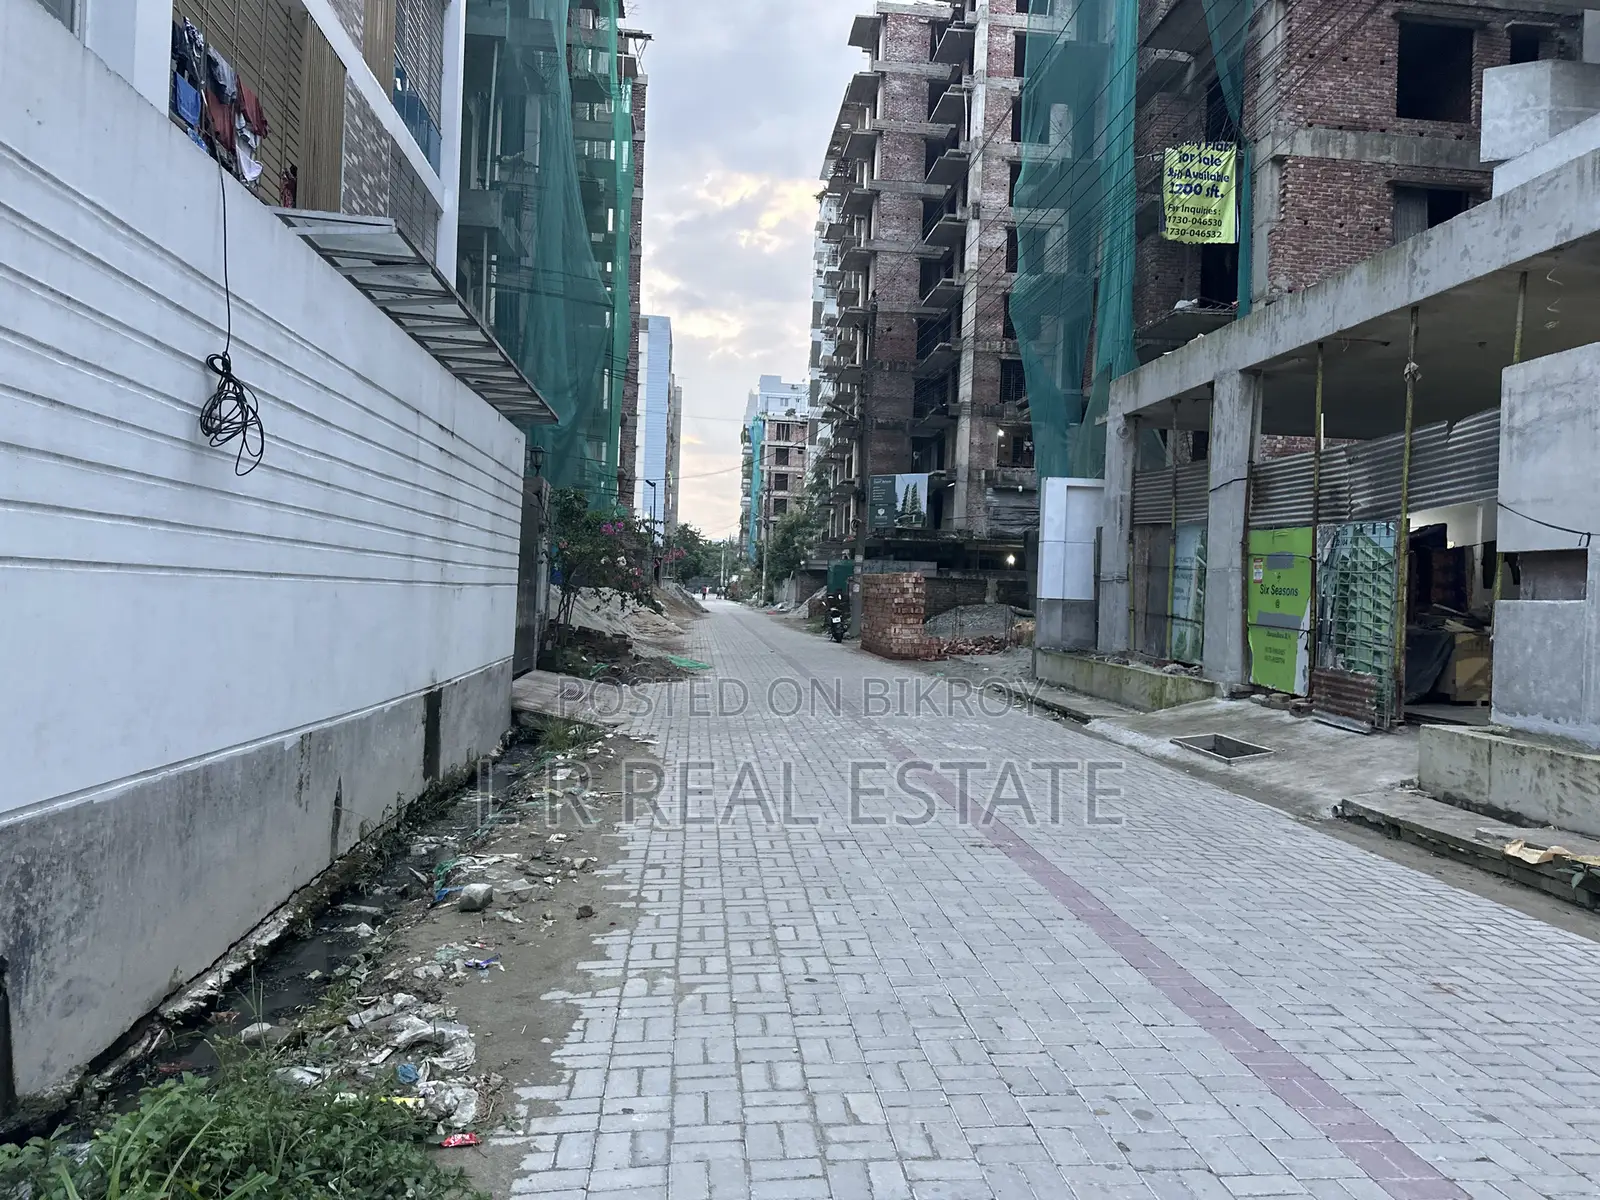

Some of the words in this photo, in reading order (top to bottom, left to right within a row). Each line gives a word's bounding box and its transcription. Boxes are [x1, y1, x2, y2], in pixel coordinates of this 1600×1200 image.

[1185, 168, 1230, 183] Available
[1168, 181, 1203, 196] 1200
[1260, 583, 1269, 595] Six
[1270, 584, 1299, 597] Seasons
